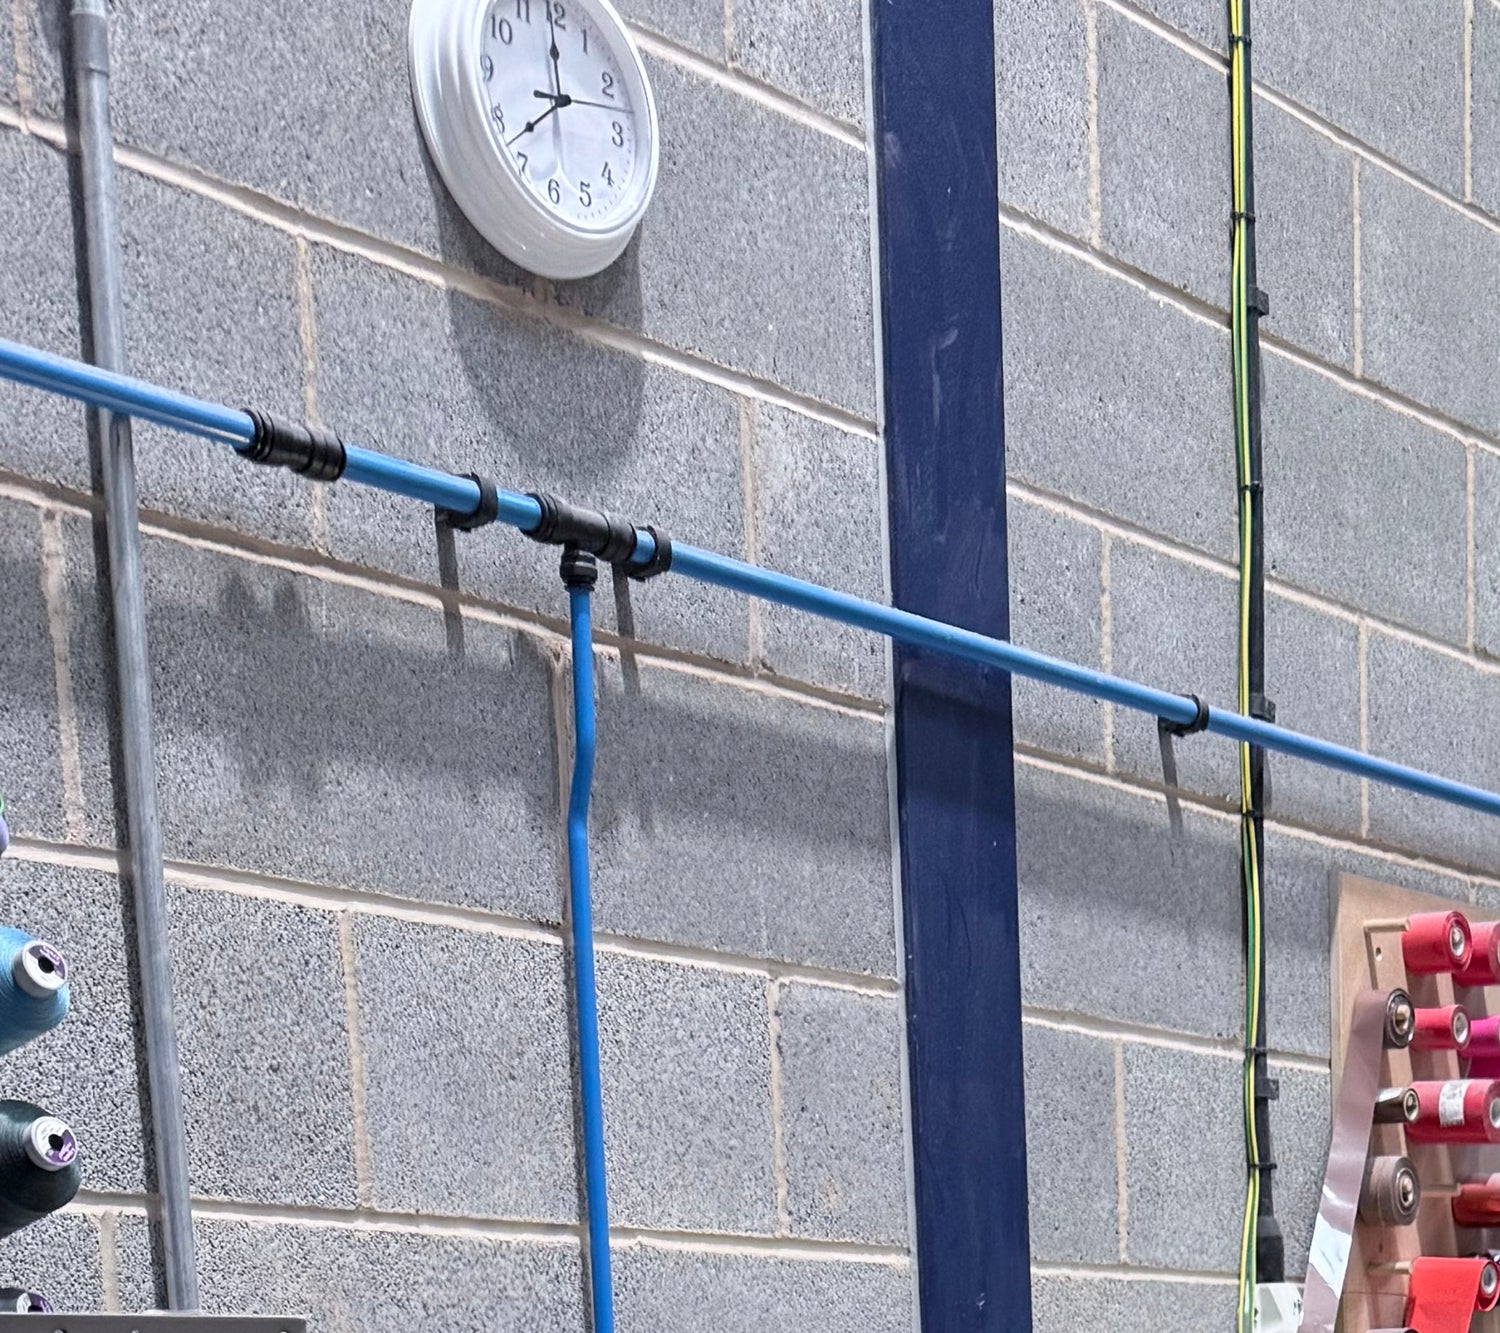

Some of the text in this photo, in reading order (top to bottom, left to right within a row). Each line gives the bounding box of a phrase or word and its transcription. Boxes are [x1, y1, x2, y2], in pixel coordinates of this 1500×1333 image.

[516, 0, 531, 25] 11
[545, 0, 566, 29] 12
[491, 14, 513, 46] 10
[580, 28, 589, 54] 1
[479, 54, 494, 83] 9
[601, 72, 615, 99] 2
[491, 103, 505, 134] 8
[611, 121, 624, 148] 3
[516, 151, 529, 178] 7
[601, 161, 615, 188] 4
[547, 178, 560, 205] 6
[578, 181, 592, 208] 5
